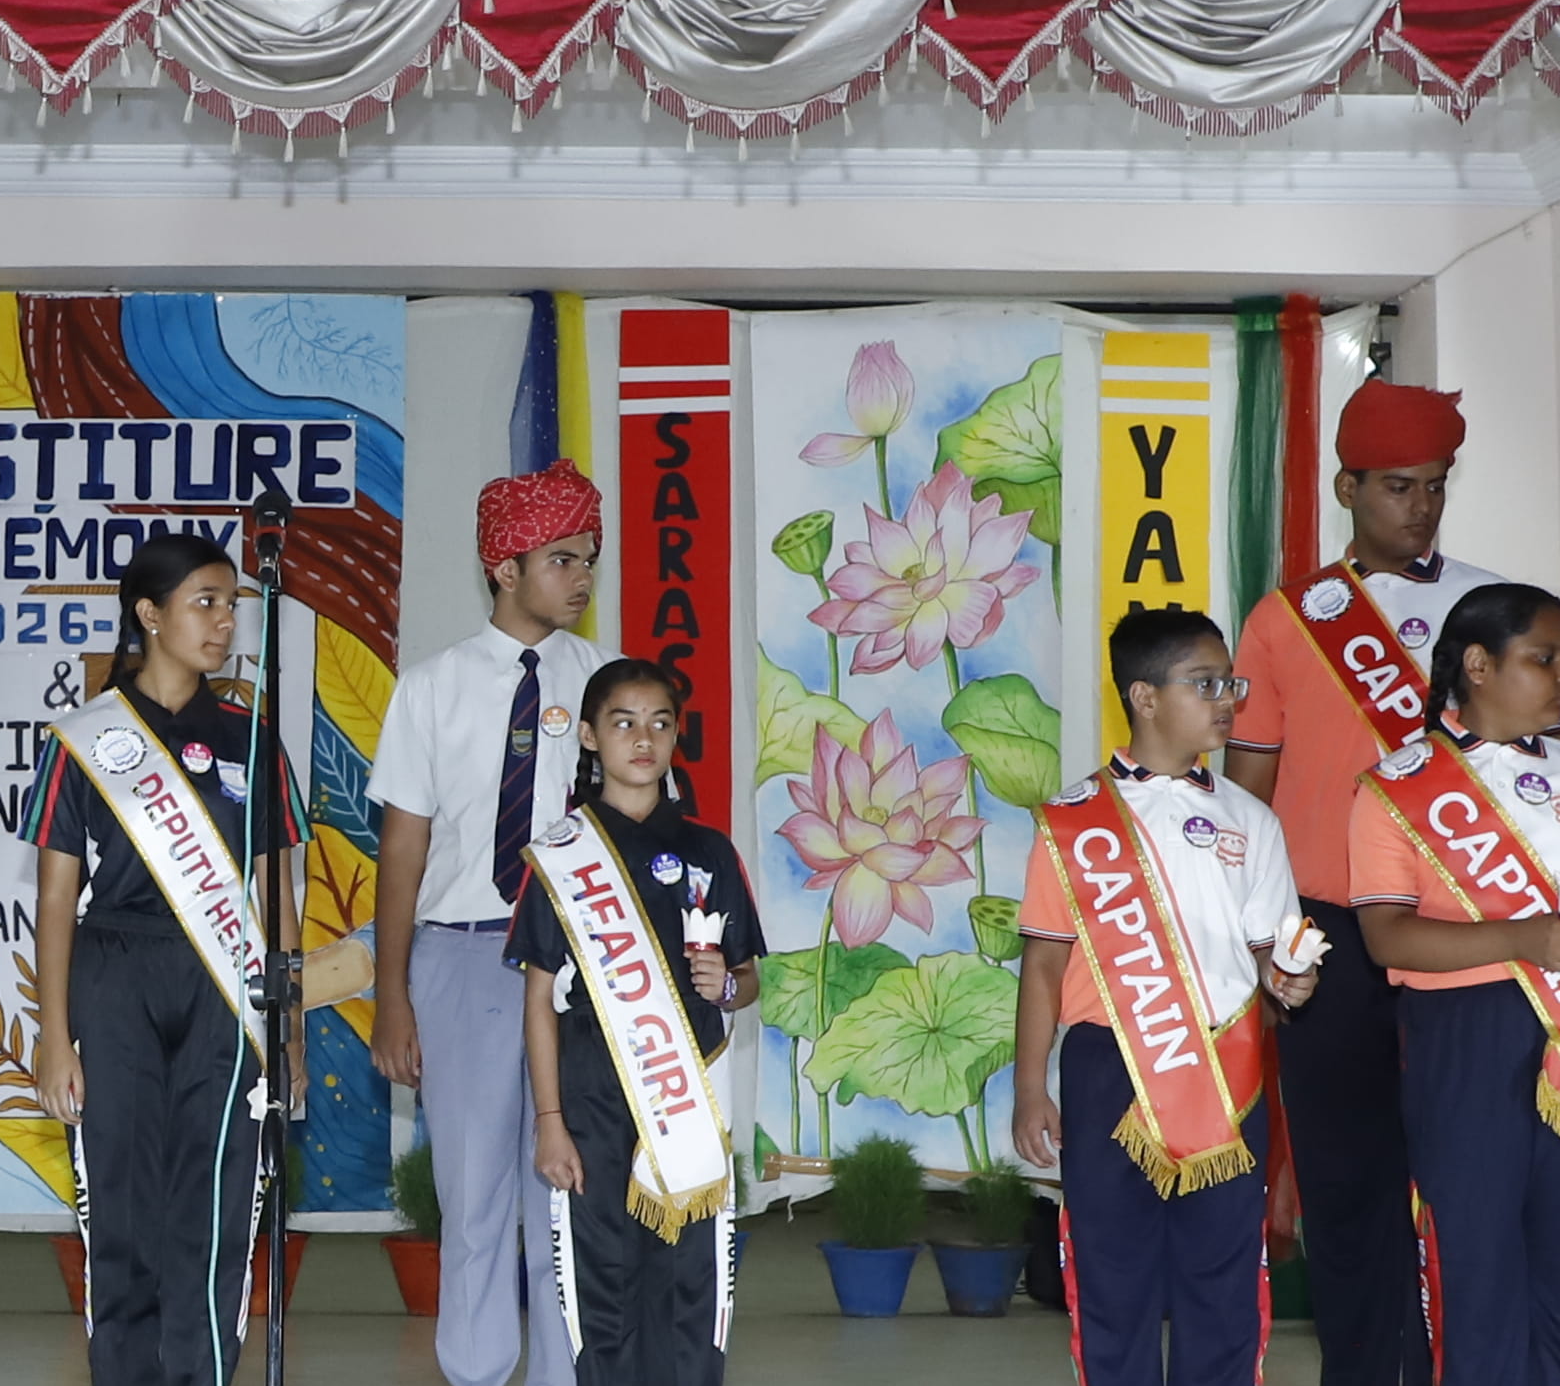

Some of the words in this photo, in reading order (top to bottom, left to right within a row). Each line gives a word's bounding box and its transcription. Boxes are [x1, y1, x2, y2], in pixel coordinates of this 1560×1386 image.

[132, 773, 224, 897] DEPUTY
[1073, 827, 1199, 1074] CAPTAIN
[563, 861, 652, 1002] HEAD
[627, 1014, 697, 1136] GIRL
